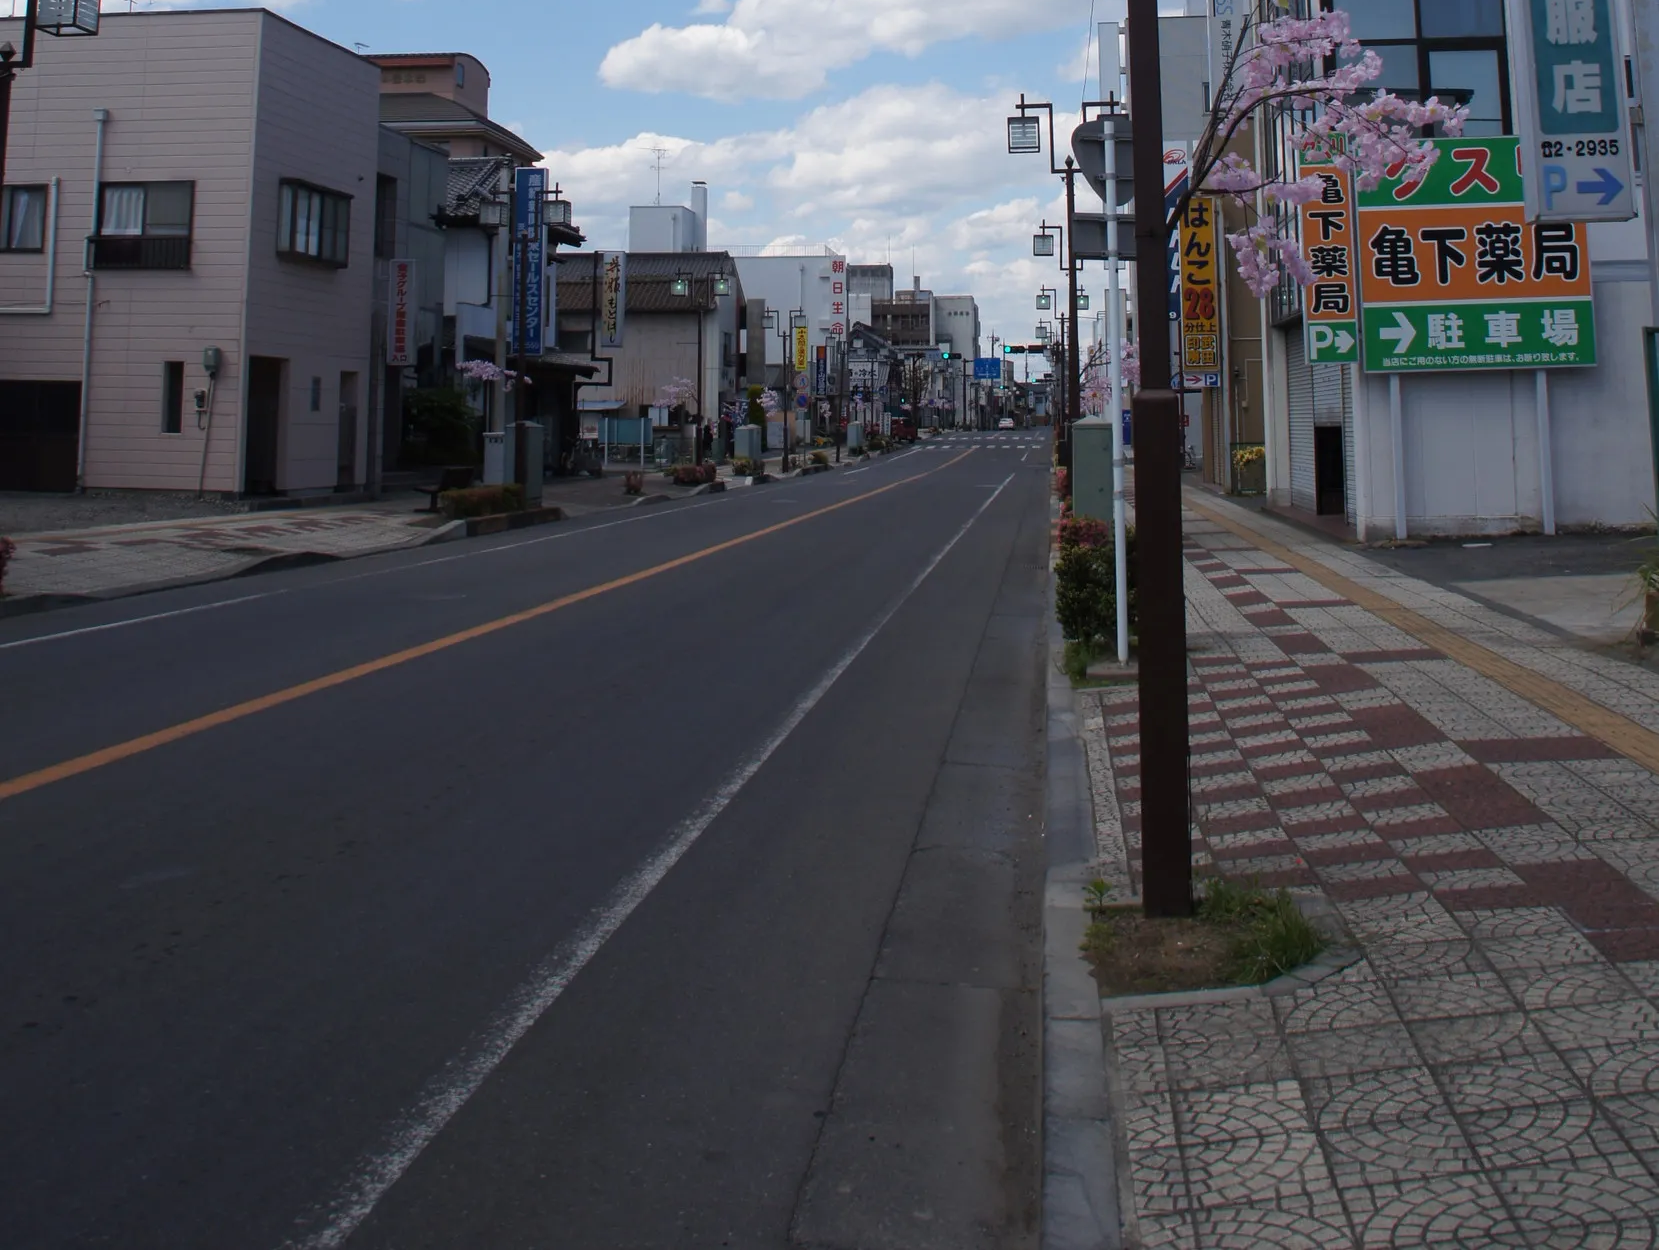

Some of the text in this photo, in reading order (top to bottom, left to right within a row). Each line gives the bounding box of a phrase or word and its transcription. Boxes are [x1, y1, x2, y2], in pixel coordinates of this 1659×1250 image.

[1543, 165, 1567, 211] P
[1184, 201, 1211, 286] はんこ
[1370, 223, 1578, 286] 亀下薬局
[832, 260, 845, 335] 朝日生命
[1184, 287, 1215, 321] 28
[1185, 322, 1217, 333] 分仕上
[1309, 325, 1333, 360] P
[1427, 308, 1579, 351] 駐車場
